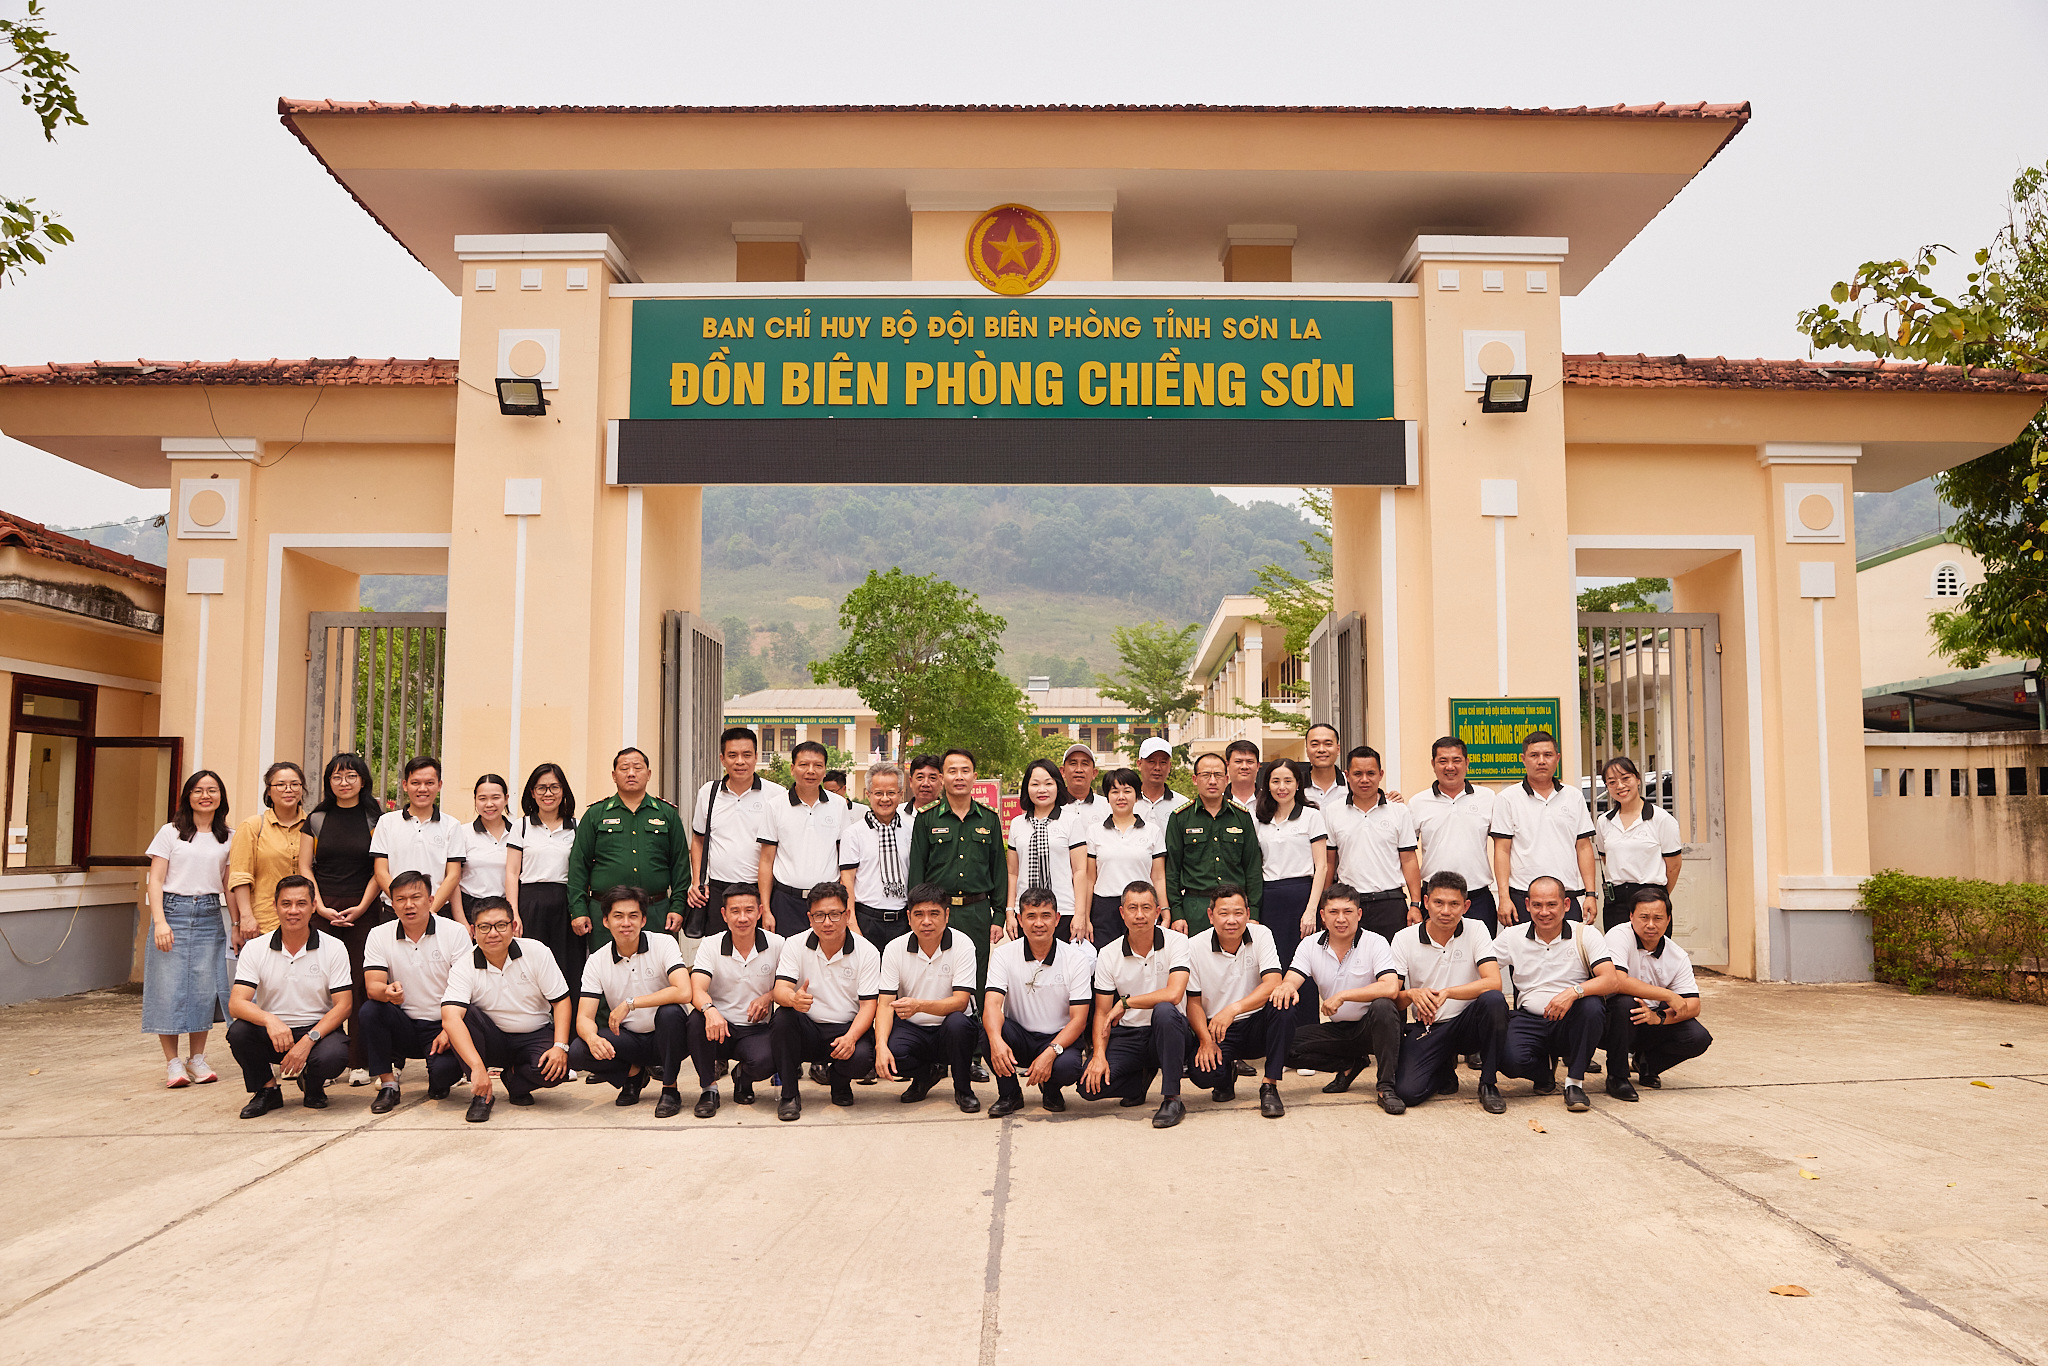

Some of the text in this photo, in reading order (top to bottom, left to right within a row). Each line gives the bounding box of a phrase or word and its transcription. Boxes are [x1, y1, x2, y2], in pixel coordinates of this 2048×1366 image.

[703, 308, 1322, 344] BAN CHỈ HUY BỘ ĐỘI BIÊN PHÒNG TỈNH SƠN LA
[669, 347, 1353, 406] ĐỒN BIÊN PHÒNG CHIỀNG SƠN
[1474, 720, 1489, 744] BIÊN
[1491, 719, 1513, 744] PHÒNG
[1482, 753, 1494, 763] SON
[1495, 753, 1518, 763] BORDER
